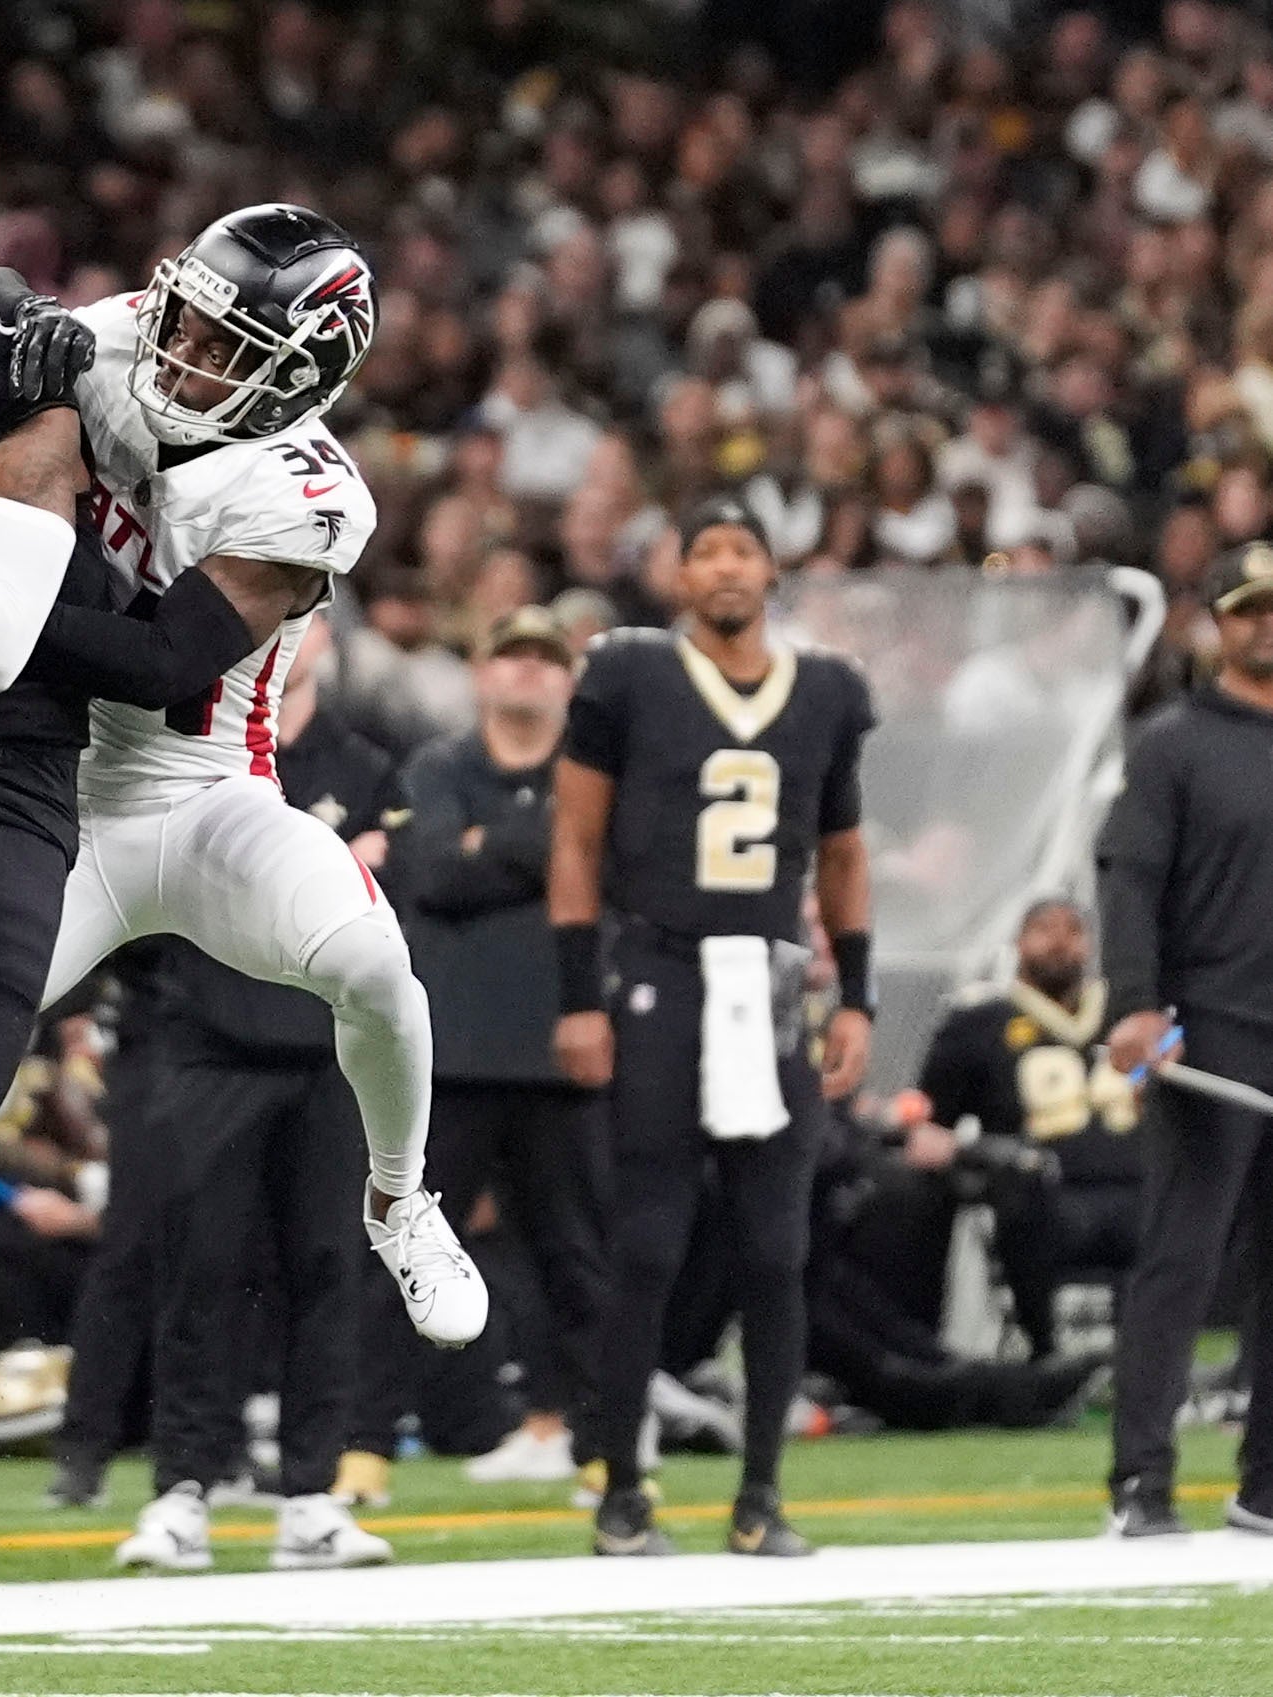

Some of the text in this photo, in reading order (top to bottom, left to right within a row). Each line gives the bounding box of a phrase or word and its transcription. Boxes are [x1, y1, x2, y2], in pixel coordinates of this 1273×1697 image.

[198, 271, 221, 294] ATL
[261, 438, 357, 480] 34
[695, 748, 781, 892] 2
